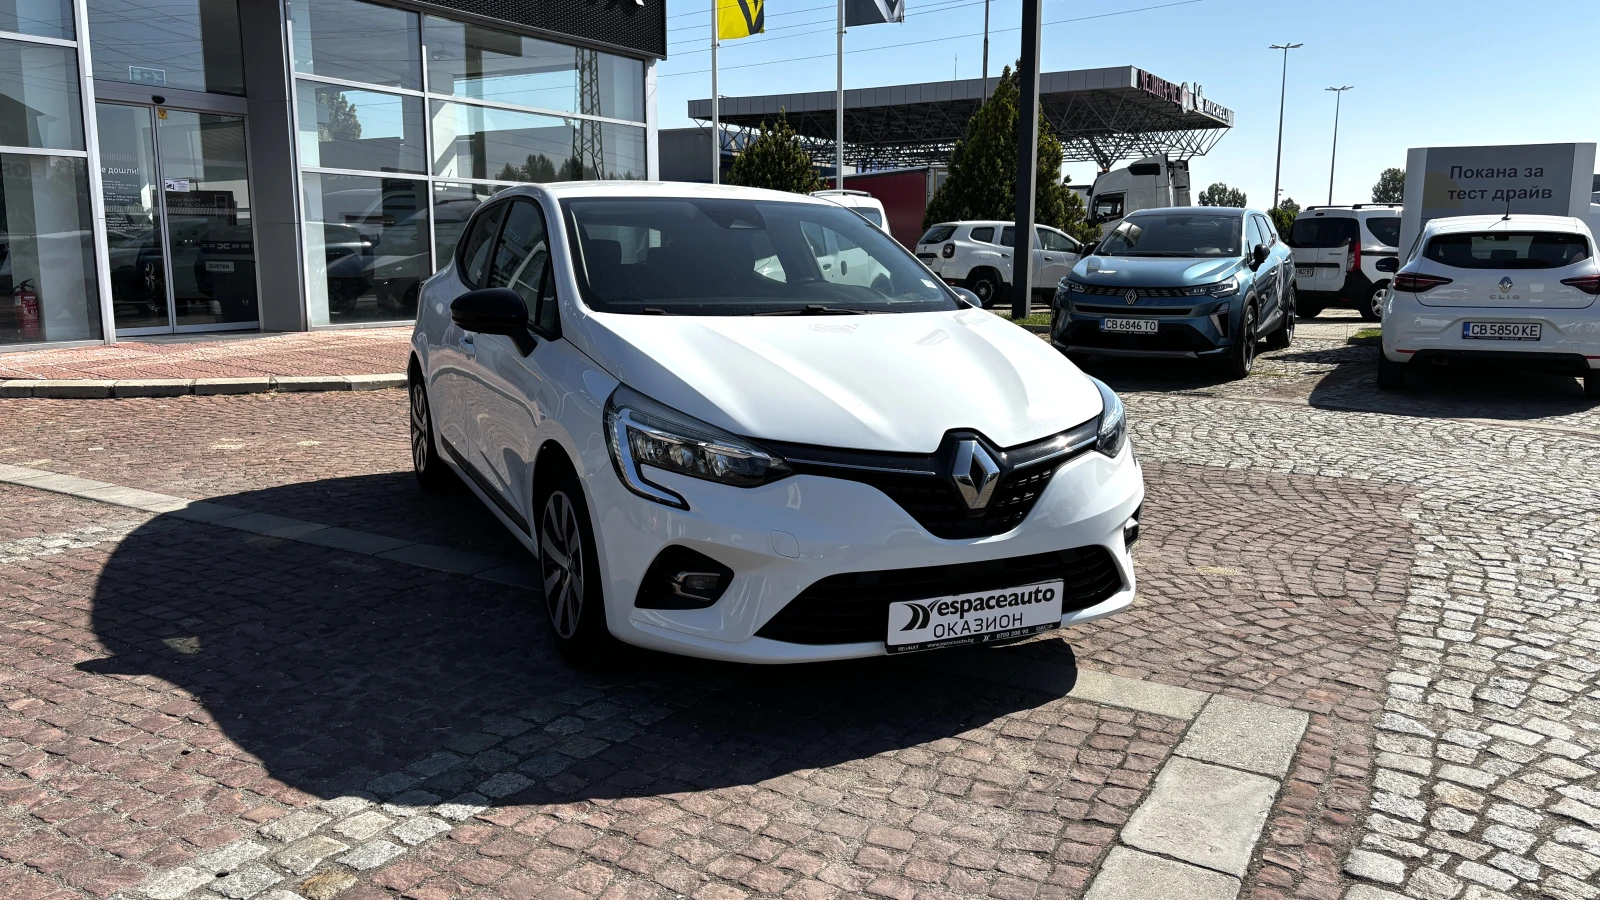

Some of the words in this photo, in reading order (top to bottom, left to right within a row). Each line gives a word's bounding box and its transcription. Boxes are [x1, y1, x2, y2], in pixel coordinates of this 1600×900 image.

[1204, 100, 1231, 122] MICHELIN
[107, 167, 140, 175] дошли!
[1449, 165, 1518, 179] Покана
[1523, 166, 1544, 178] за
[1447, 189, 1488, 200] тест
[1491, 185, 1553, 202] драйв
[1105, 319, 1118, 329] CB
[1119, 320, 1142, 330] 6846
[1143, 321, 1156, 331] TO
[1471, 324, 1488, 335] CB
[1489, 324, 1520, 336] 5850
[1521, 325, 1538, 337] KE
[936, 585, 1056, 619] espaceauto
[933, 612, 1023, 639] ОКАЗИОН
[996, 631, 1010, 640] 0700
